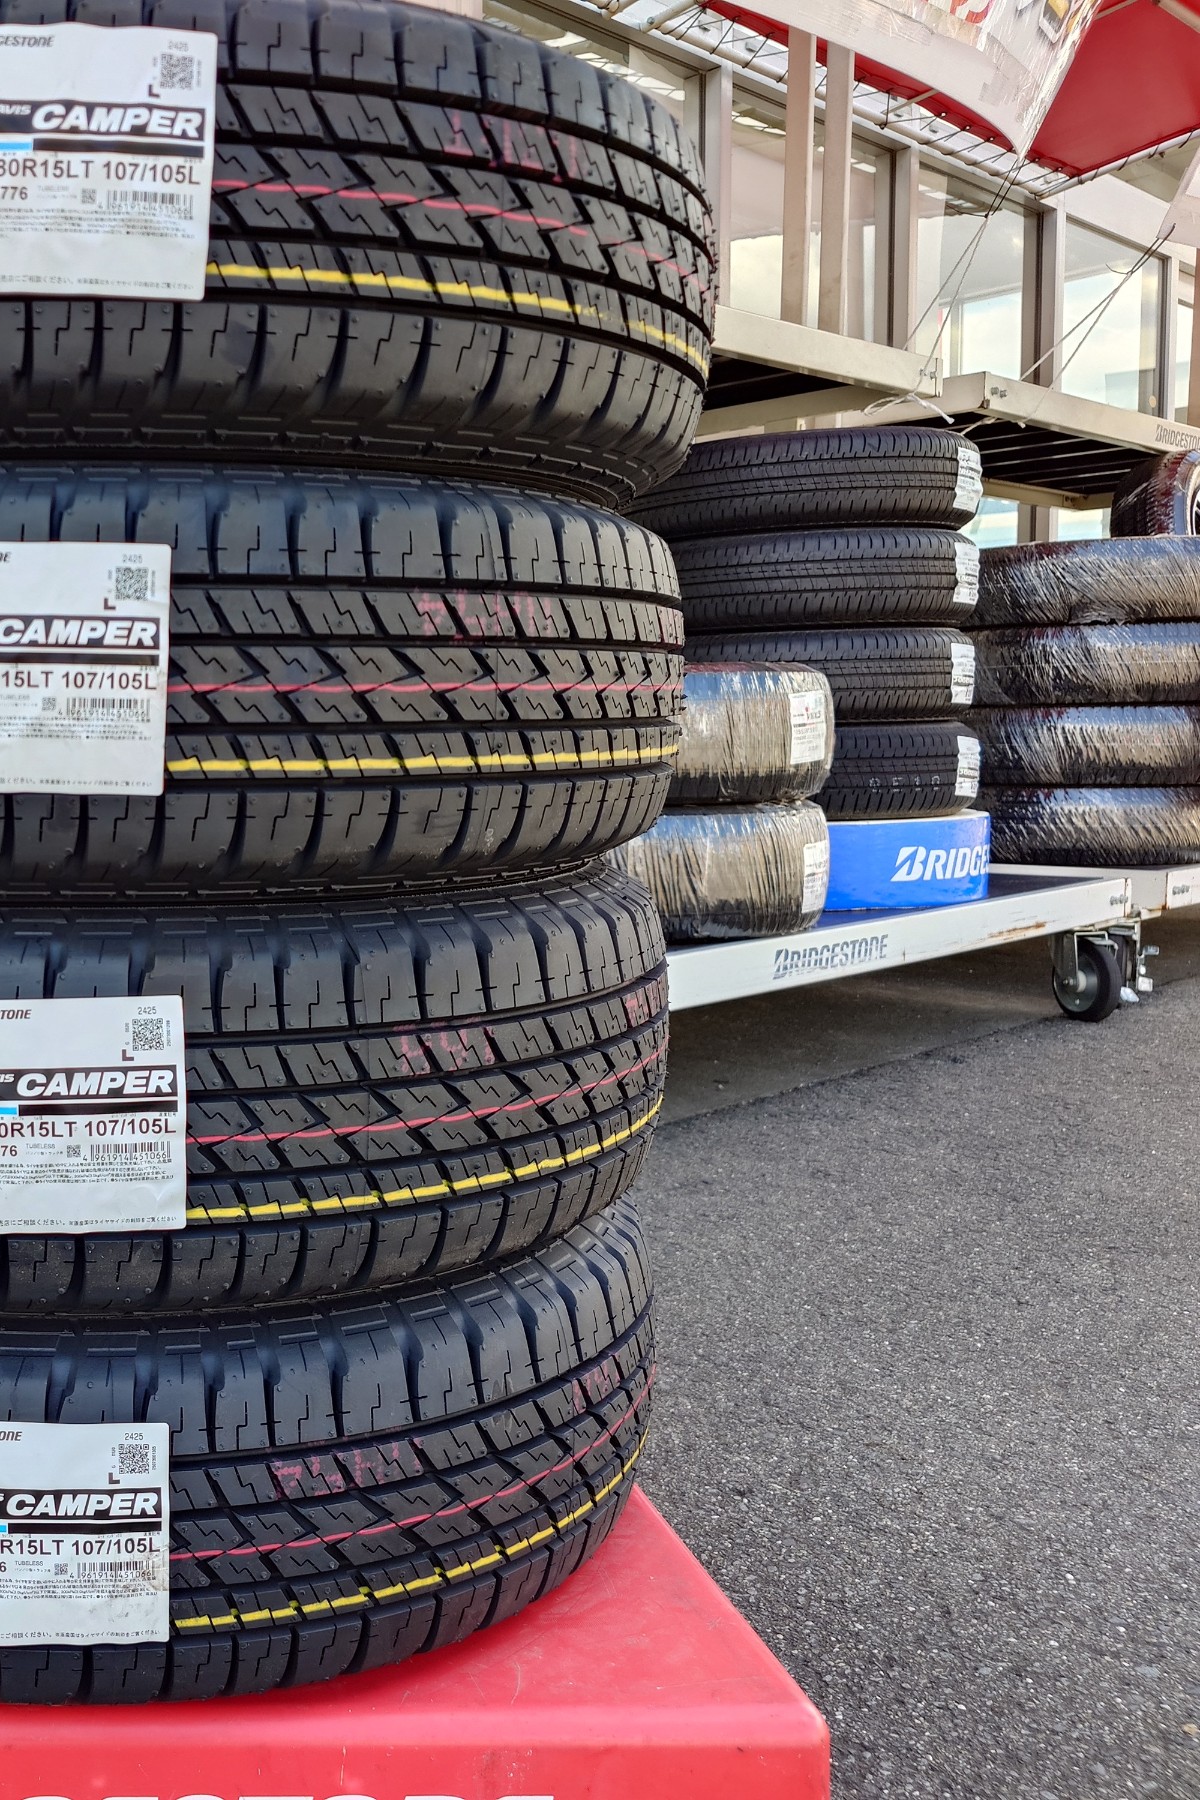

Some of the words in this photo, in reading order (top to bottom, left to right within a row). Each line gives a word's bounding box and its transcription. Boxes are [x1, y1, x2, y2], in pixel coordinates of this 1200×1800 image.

[148, 84, 160, 98] L
[32, 104, 203, 138] CAMPER
[103, 161, 201, 185] 107/105L
[103, 597, 116, 610] L
[62, 672, 157, 690] 107/105L
[890, 845, 989, 882] BRIDGE
[772, 934, 889, 980] BRIDGESTONE
[137, 1006, 157, 1015] 2425
[122, 1049, 134, 1061] L
[16, 1070, 174, 1097] CAMPER
[85, 1118, 176, 1137] 107/105L
[124, 1433, 144, 1441] 2425
[108, 1472, 120, 1485] L
[6, 1492, 158, 1517] CAMPER
[72, 1537, 160, 1555] 107/105L
